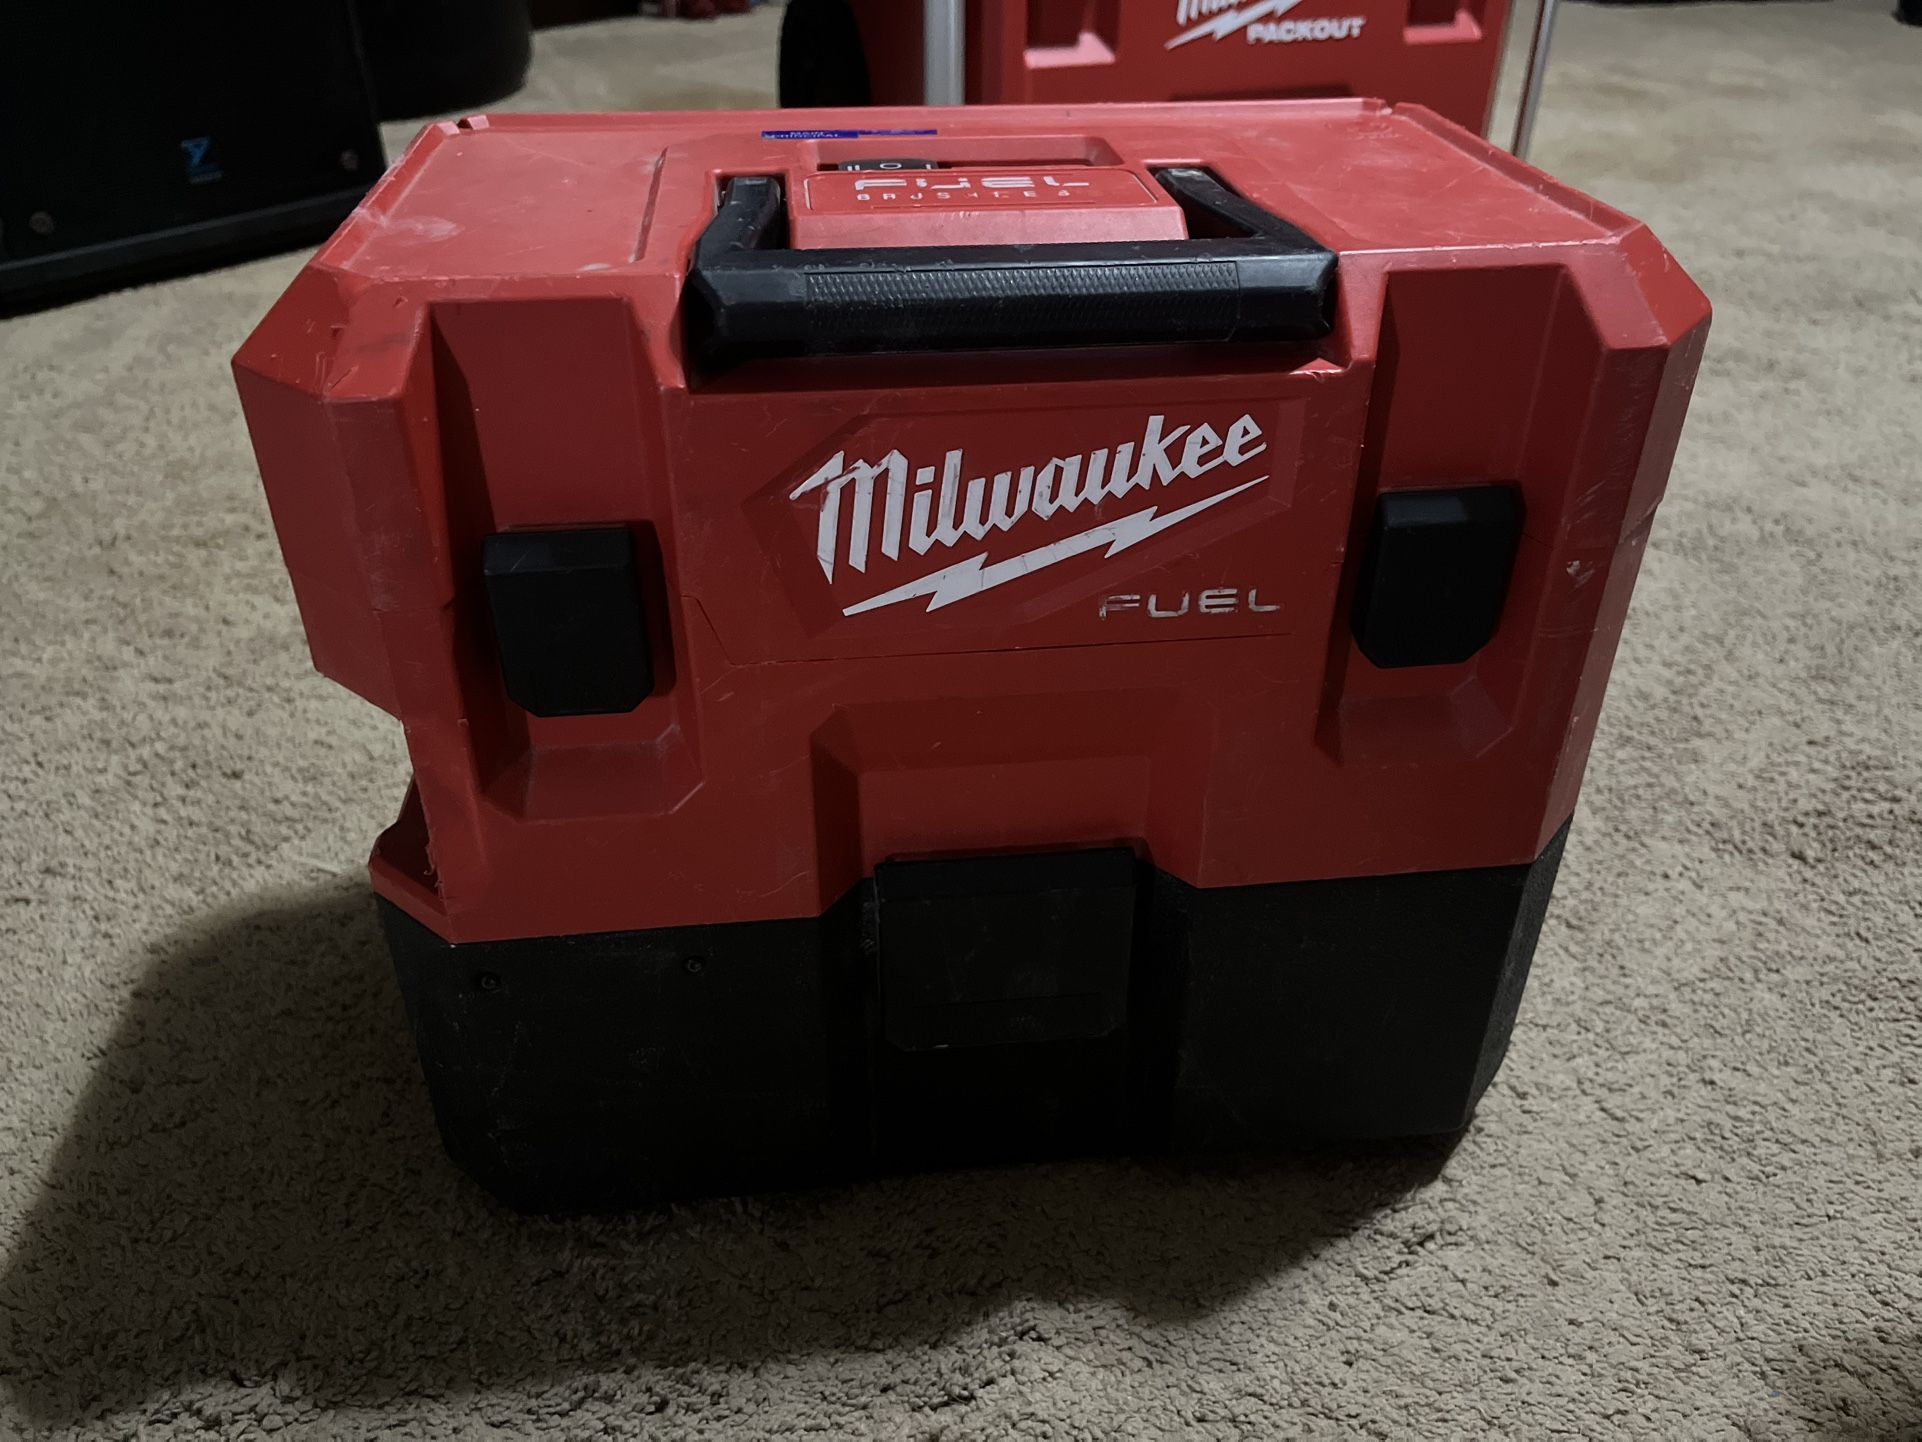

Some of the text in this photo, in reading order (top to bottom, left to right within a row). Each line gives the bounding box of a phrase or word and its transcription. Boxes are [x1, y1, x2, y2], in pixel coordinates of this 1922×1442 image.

[1247, 16, 1366, 44] PACKOUT
[854, 175, 1091, 191] FUEL
[789, 413, 1267, 585] Milwaukee
[1099, 588, 1281, 620] FUEL
